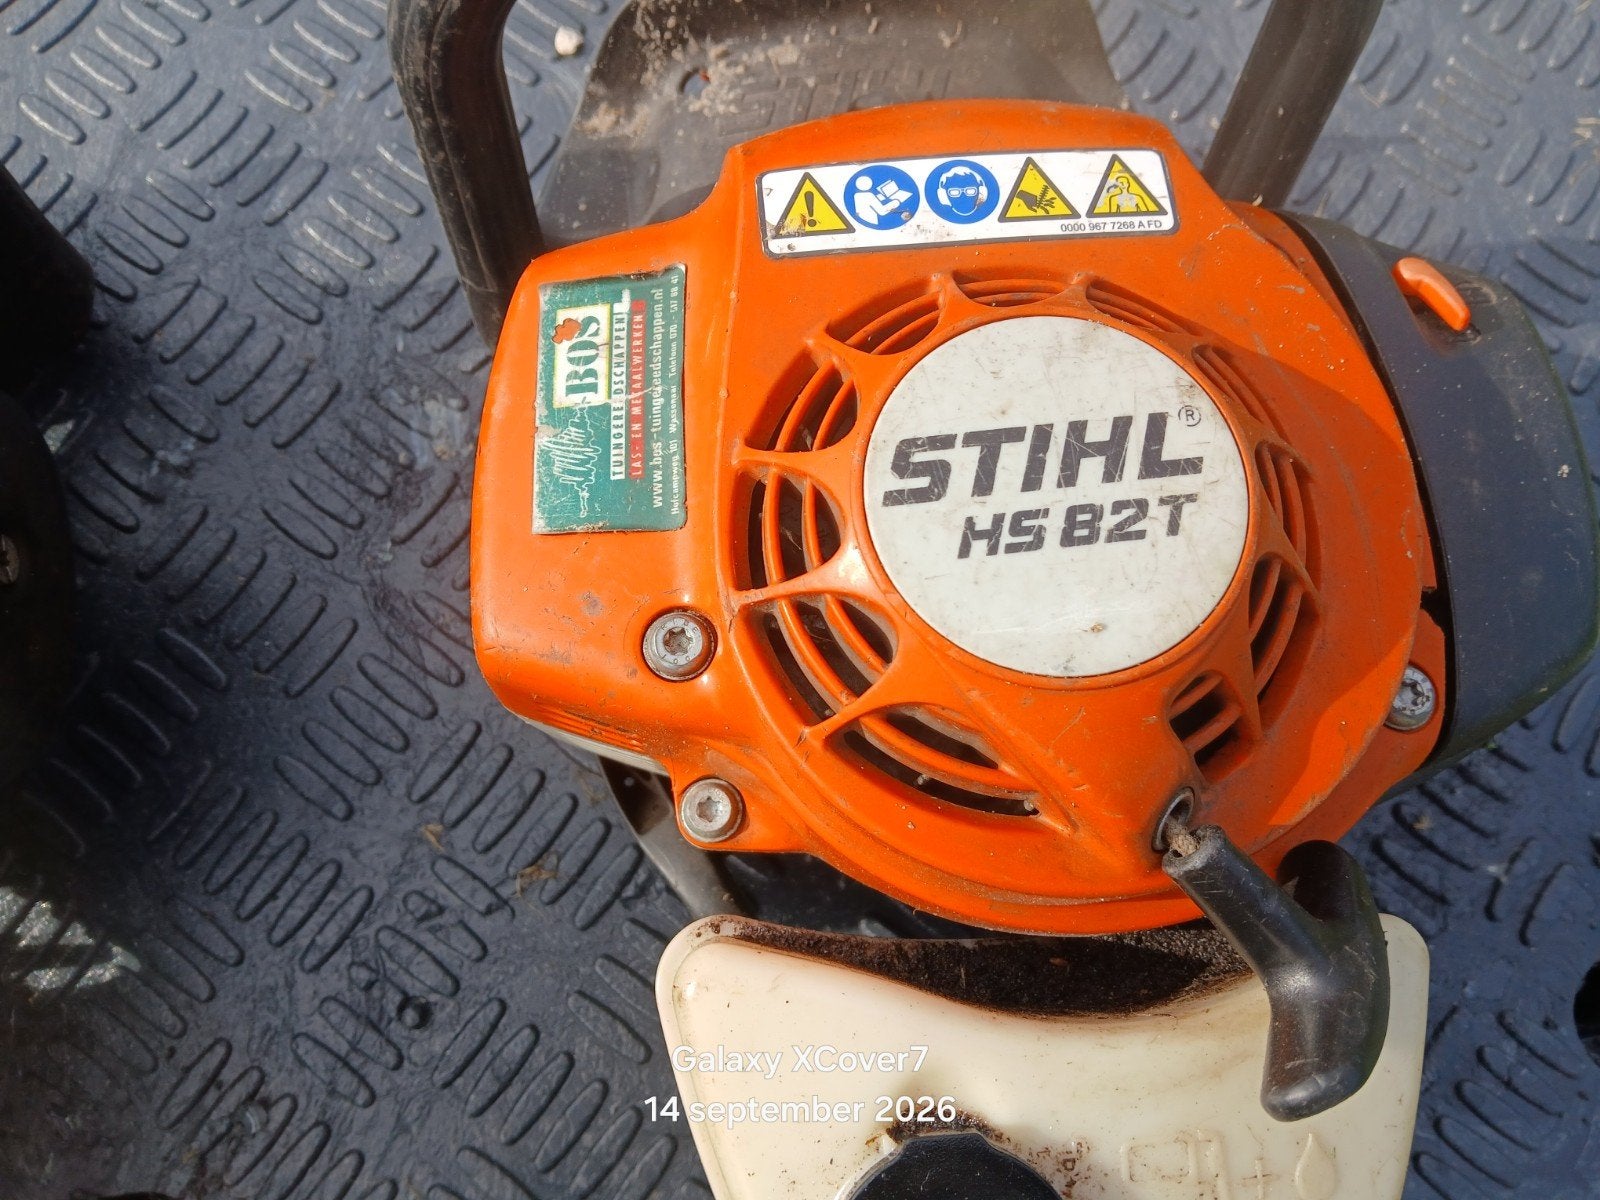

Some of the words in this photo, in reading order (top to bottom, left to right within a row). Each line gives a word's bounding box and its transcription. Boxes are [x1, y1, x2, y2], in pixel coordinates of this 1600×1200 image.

[1060, 222, 1086, 232] 0000
[1088, 221, 1107, 231] 967
[1110, 220, 1136, 230] 7268
[1137, 220, 1146, 229] A
[1147, 219, 1162, 229] FD
[669, 324, 678, 339] 070
[565, 315, 600, 398] BOS
[631, 314, 644, 415] METAALWERKEN
[668, 341, 678, 379] Telefoon
[612, 316, 627, 478] TUINGEREDSCHAPPEN
[631, 423, 643, 439] EN
[669, 439, 678, 454] 101
[631, 445, 643, 476] LAS-
[882, 411, 1204, 507] STIHL
[958, 508, 1050, 559] HS
